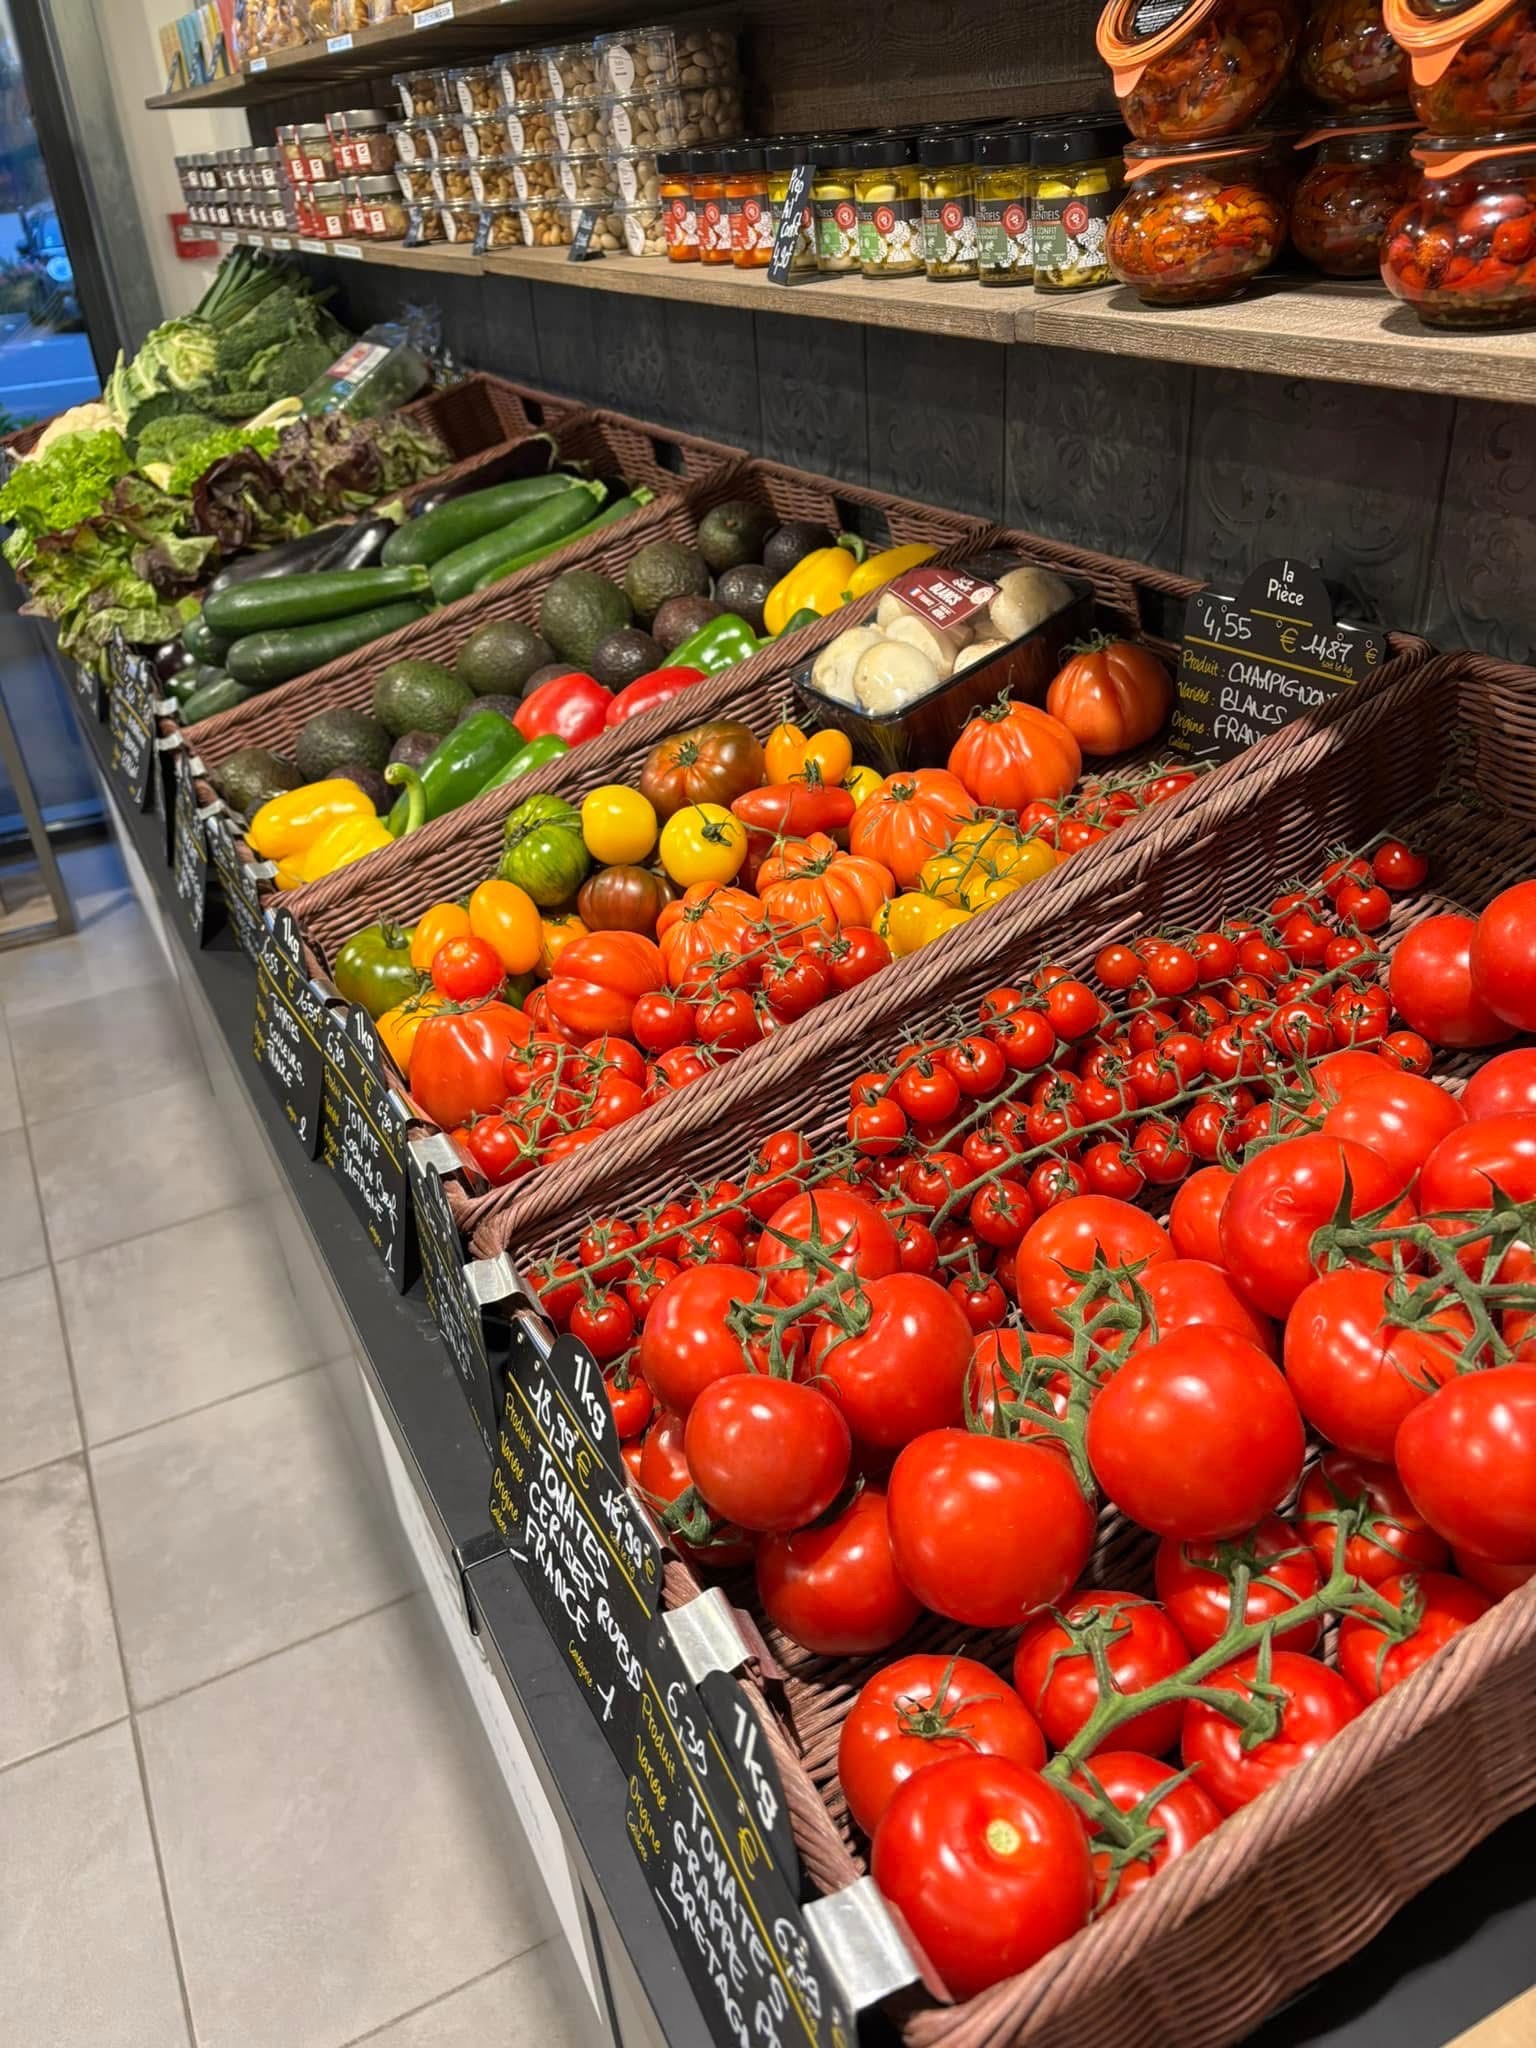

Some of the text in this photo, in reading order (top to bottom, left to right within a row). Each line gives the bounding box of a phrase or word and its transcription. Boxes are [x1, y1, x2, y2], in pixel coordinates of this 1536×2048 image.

[1267, 578, 1304, 606] Pièce
[1282, 560, 1295, 583] la
[1203, 606, 1378, 664] 4,55 € 11,87 €
[1220, 687, 1288, 725] BLANCS
[1228, 662, 1338, 706] CHAMPIGNON
[1214, 714, 1267, 745] FRAN
[355, 1011, 374, 1062] 1kg
[573, 1354, 605, 1441] 1kg
[528, 1378, 576, 1470] 18,99
[576, 1450, 592, 1489] €
[644, 1558, 655, 1584] €
[538, 1443, 610, 1590] TOMATES
[494, 1467, 519, 1521] Origine
[525, 1514, 590, 1642] FRANCE
[528, 1482, 595, 1602] CERISES
[667, 1681, 708, 1776] 6,39
[737, 1826, 759, 1880] €
[733, 1703, 778, 1832] 1kg
[630, 1775, 661, 1854] Origine
[642, 1692, 675, 1784] Produit
[688, 1785, 789, 2022] TOMATES
[674, 1820, 748, 1994] GRAPPE
